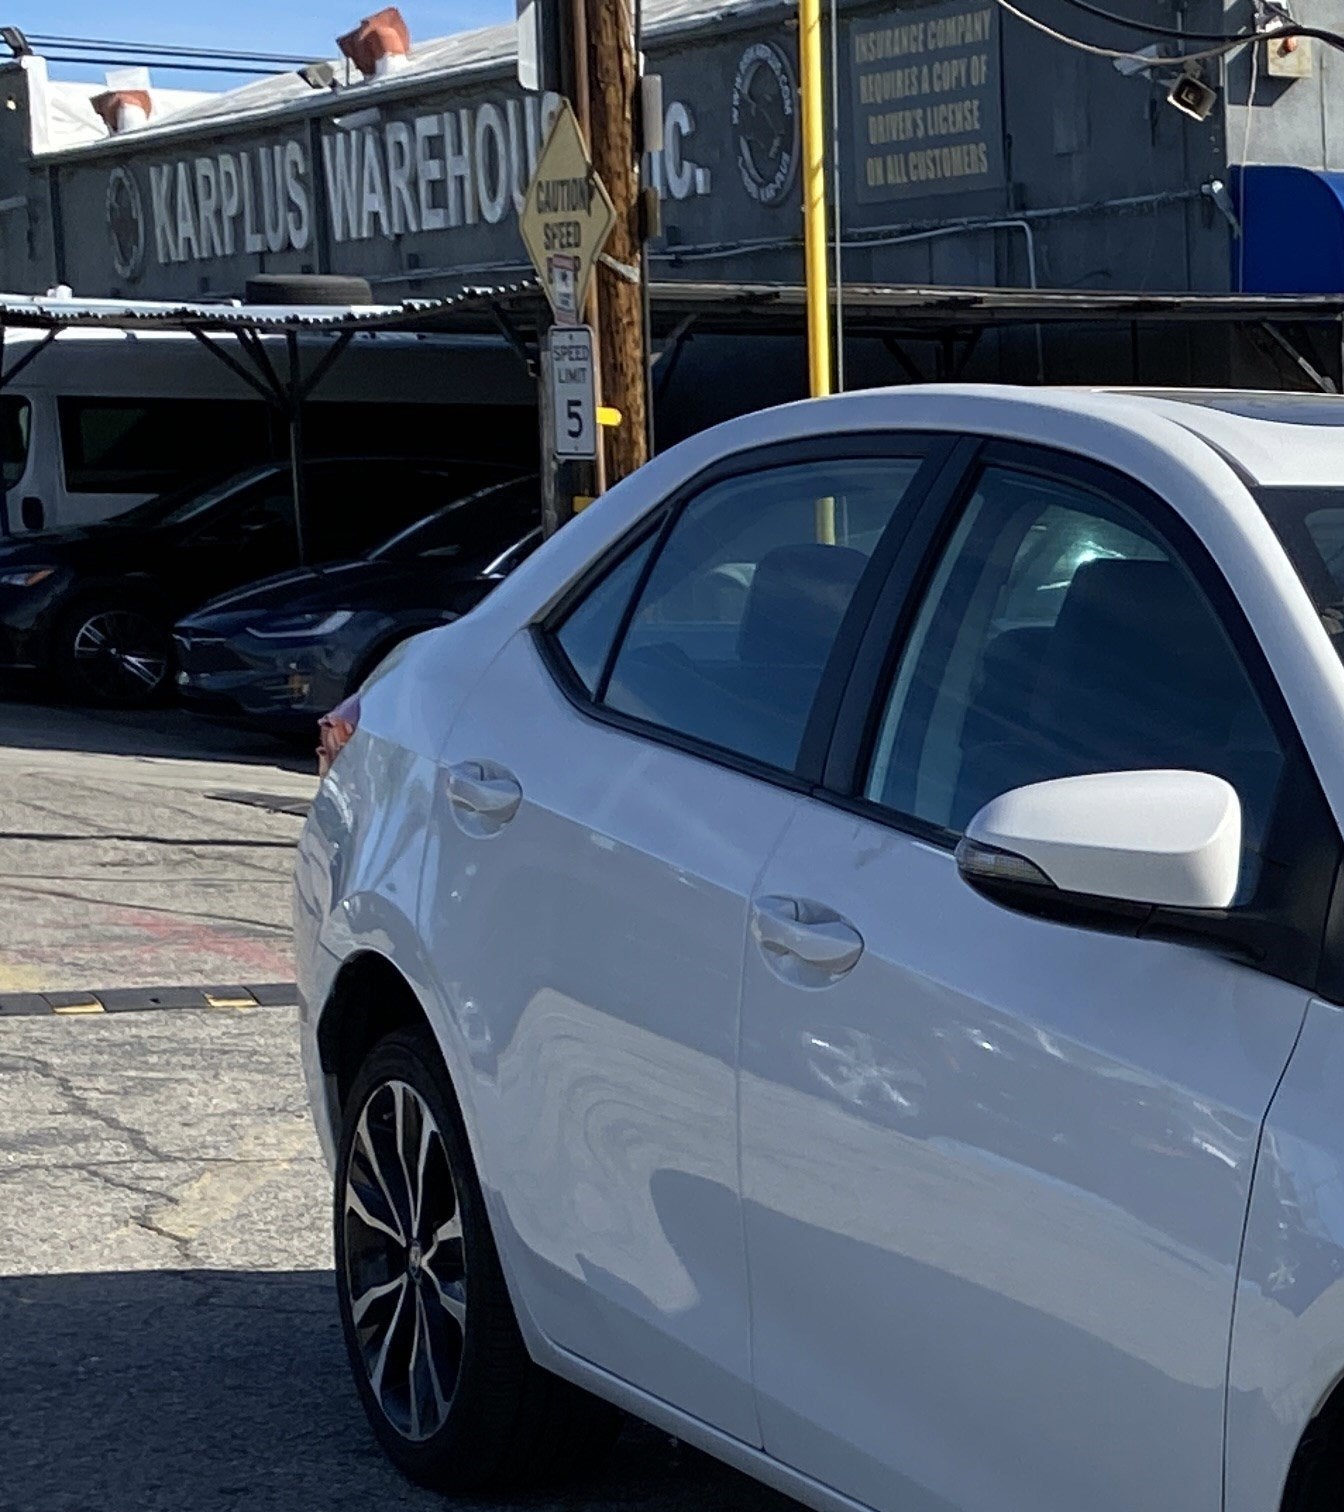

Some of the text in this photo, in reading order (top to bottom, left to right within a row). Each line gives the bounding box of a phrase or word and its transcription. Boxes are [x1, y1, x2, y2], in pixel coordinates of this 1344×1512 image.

[926, 9, 991, 51] COMPANY
[921, 64, 931, 94] A
[932, 57, 968, 93] COPY
[970, 53, 987, 87] OF
[926, 99, 980, 136] LICENSE
[908, 142, 988, 182] CUSTOMERS
[149, 140, 309, 263] KARPLUS
[543, 220, 582, 250] SPEED
[553, 344, 589, 361] SPEED
[557, 366, 587, 384] LIMIT
[566, 398, 583, 439] 5
